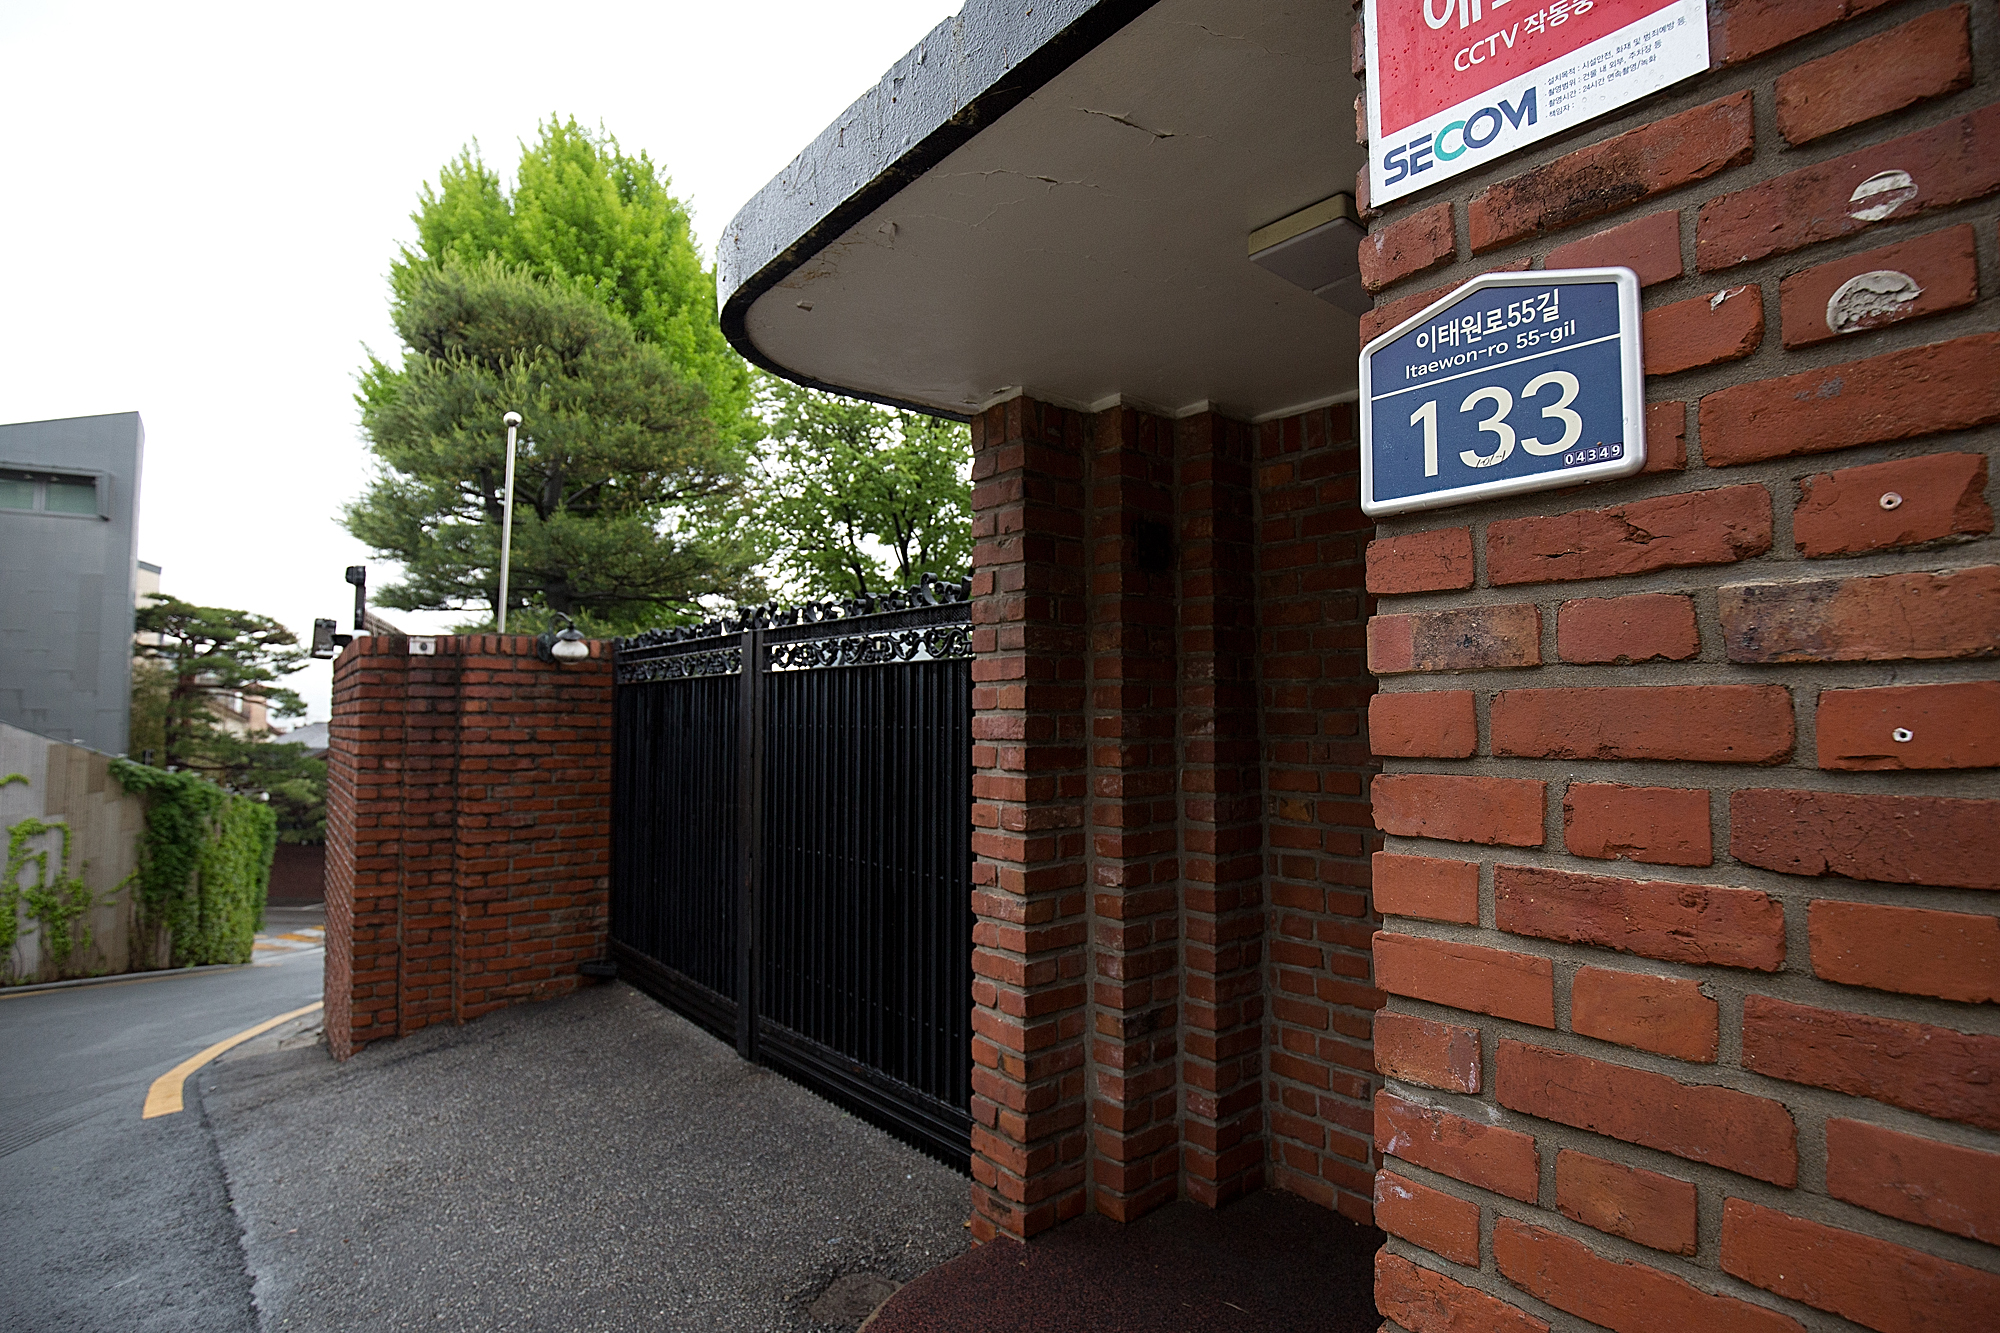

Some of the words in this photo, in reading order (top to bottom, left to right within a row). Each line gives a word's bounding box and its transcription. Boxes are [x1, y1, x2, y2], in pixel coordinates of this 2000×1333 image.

[1453, 22, 1519, 72] CCTV
[1548, 67, 1576, 85] 설치목적
[1616, 42, 1631, 54] 화재
[1633, 36, 1641, 46] 및
[1643, 21, 1674, 41] 범죄예방
[1548, 78, 1576, 96] 촬영범위
[1582, 69, 1597, 83] 건물
[1599, 64, 1607, 73] 내
[1628, 44, 1652, 60] 주차장
[1549, 89, 1577, 108] 촬영시간
[1582, 76, 1605, 93] 24시간
[1549, 104, 1570, 118] 책임자
[1383, 86, 1538, 186] SECOM
[1416, 289, 1560, 353] 이태원로55길
[1405, 340, 1509, 379] Itaewon-ro
[1516, 320, 1576, 349] 55-gil
[1410, 370, 1583, 478] 133
[1564, 442, 1623, 467] 04349
